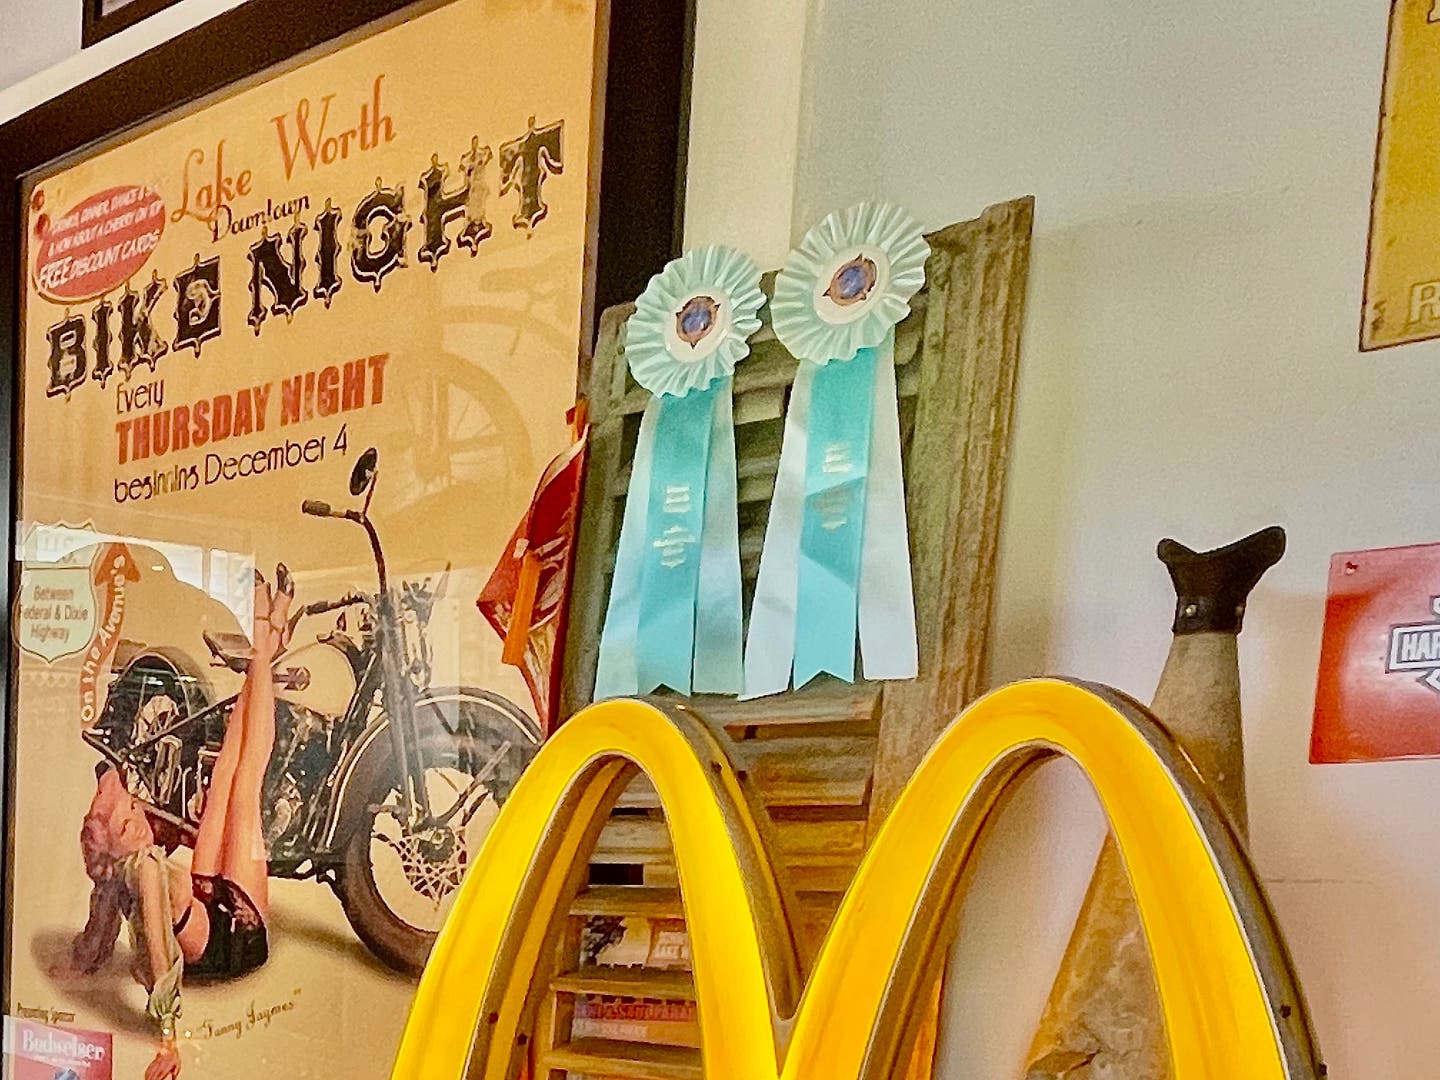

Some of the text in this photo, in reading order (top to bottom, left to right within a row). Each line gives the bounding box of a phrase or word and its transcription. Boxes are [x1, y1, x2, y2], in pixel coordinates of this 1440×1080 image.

[171, 74, 397, 223] Lake Worth
[209, 195, 310, 242] Downtown
[40, 255, 73, 289] FREE
[46, 116, 564, 402] BIKE NIGHT
[115, 353, 390, 465] THURSDAY NIGHT
[116, 379, 165, 415] Every
[203, 436, 326, 486] December
[333, 423, 348, 456] 4
[22, 1028, 107, 1062] Budweiser
